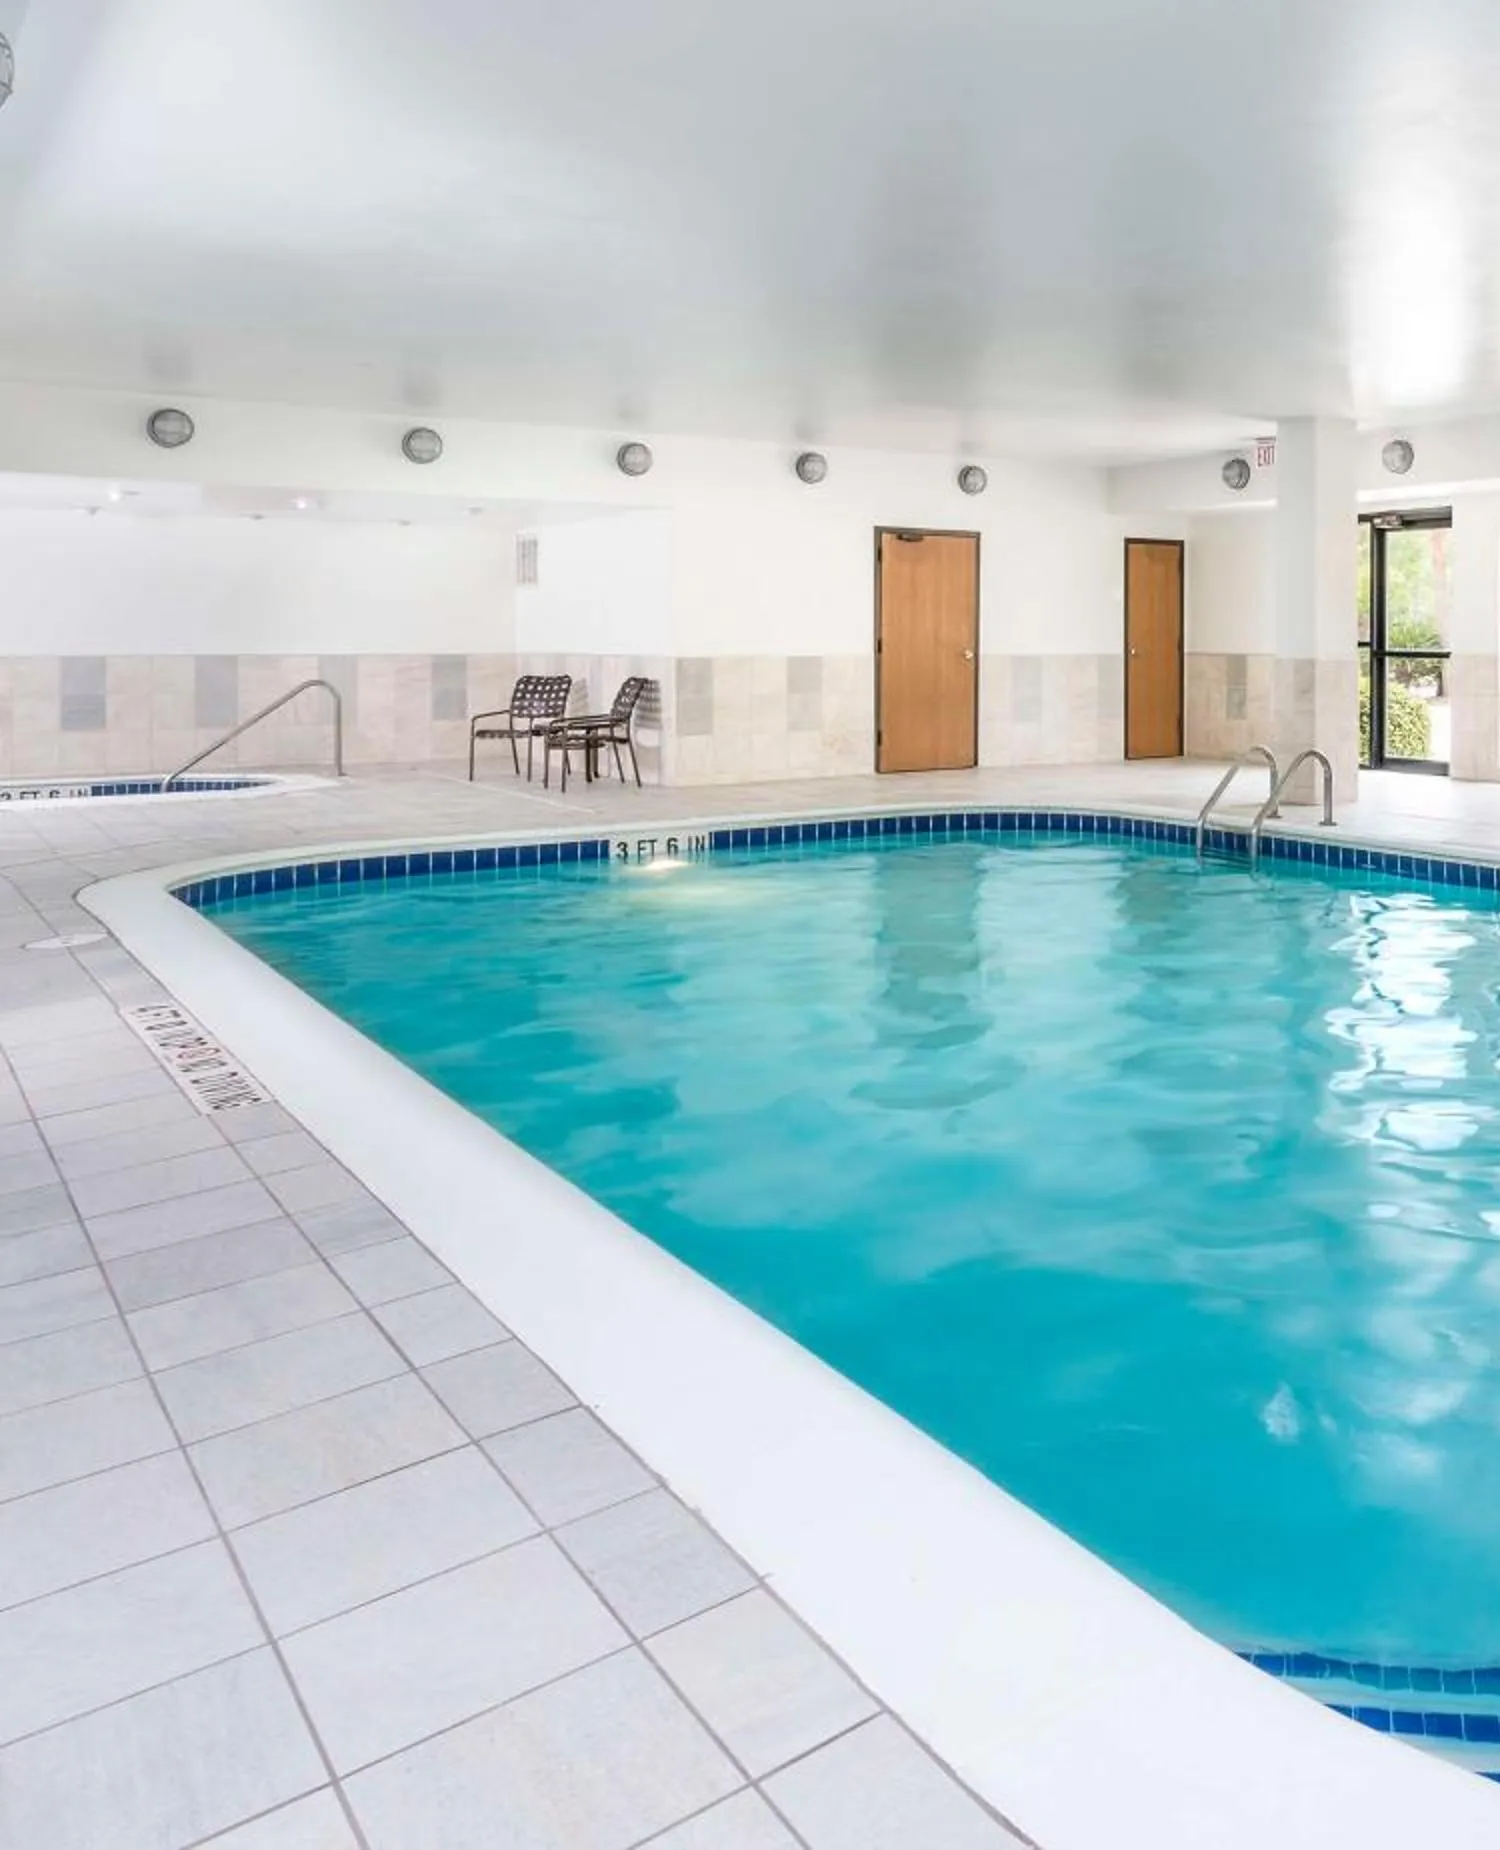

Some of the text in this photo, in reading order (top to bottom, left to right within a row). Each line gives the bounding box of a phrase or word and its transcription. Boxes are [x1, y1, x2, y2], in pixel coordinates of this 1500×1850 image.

[1257, 445, 1275, 467] EXIT
[616, 835, 706, 862] 3 FT 6 IN
